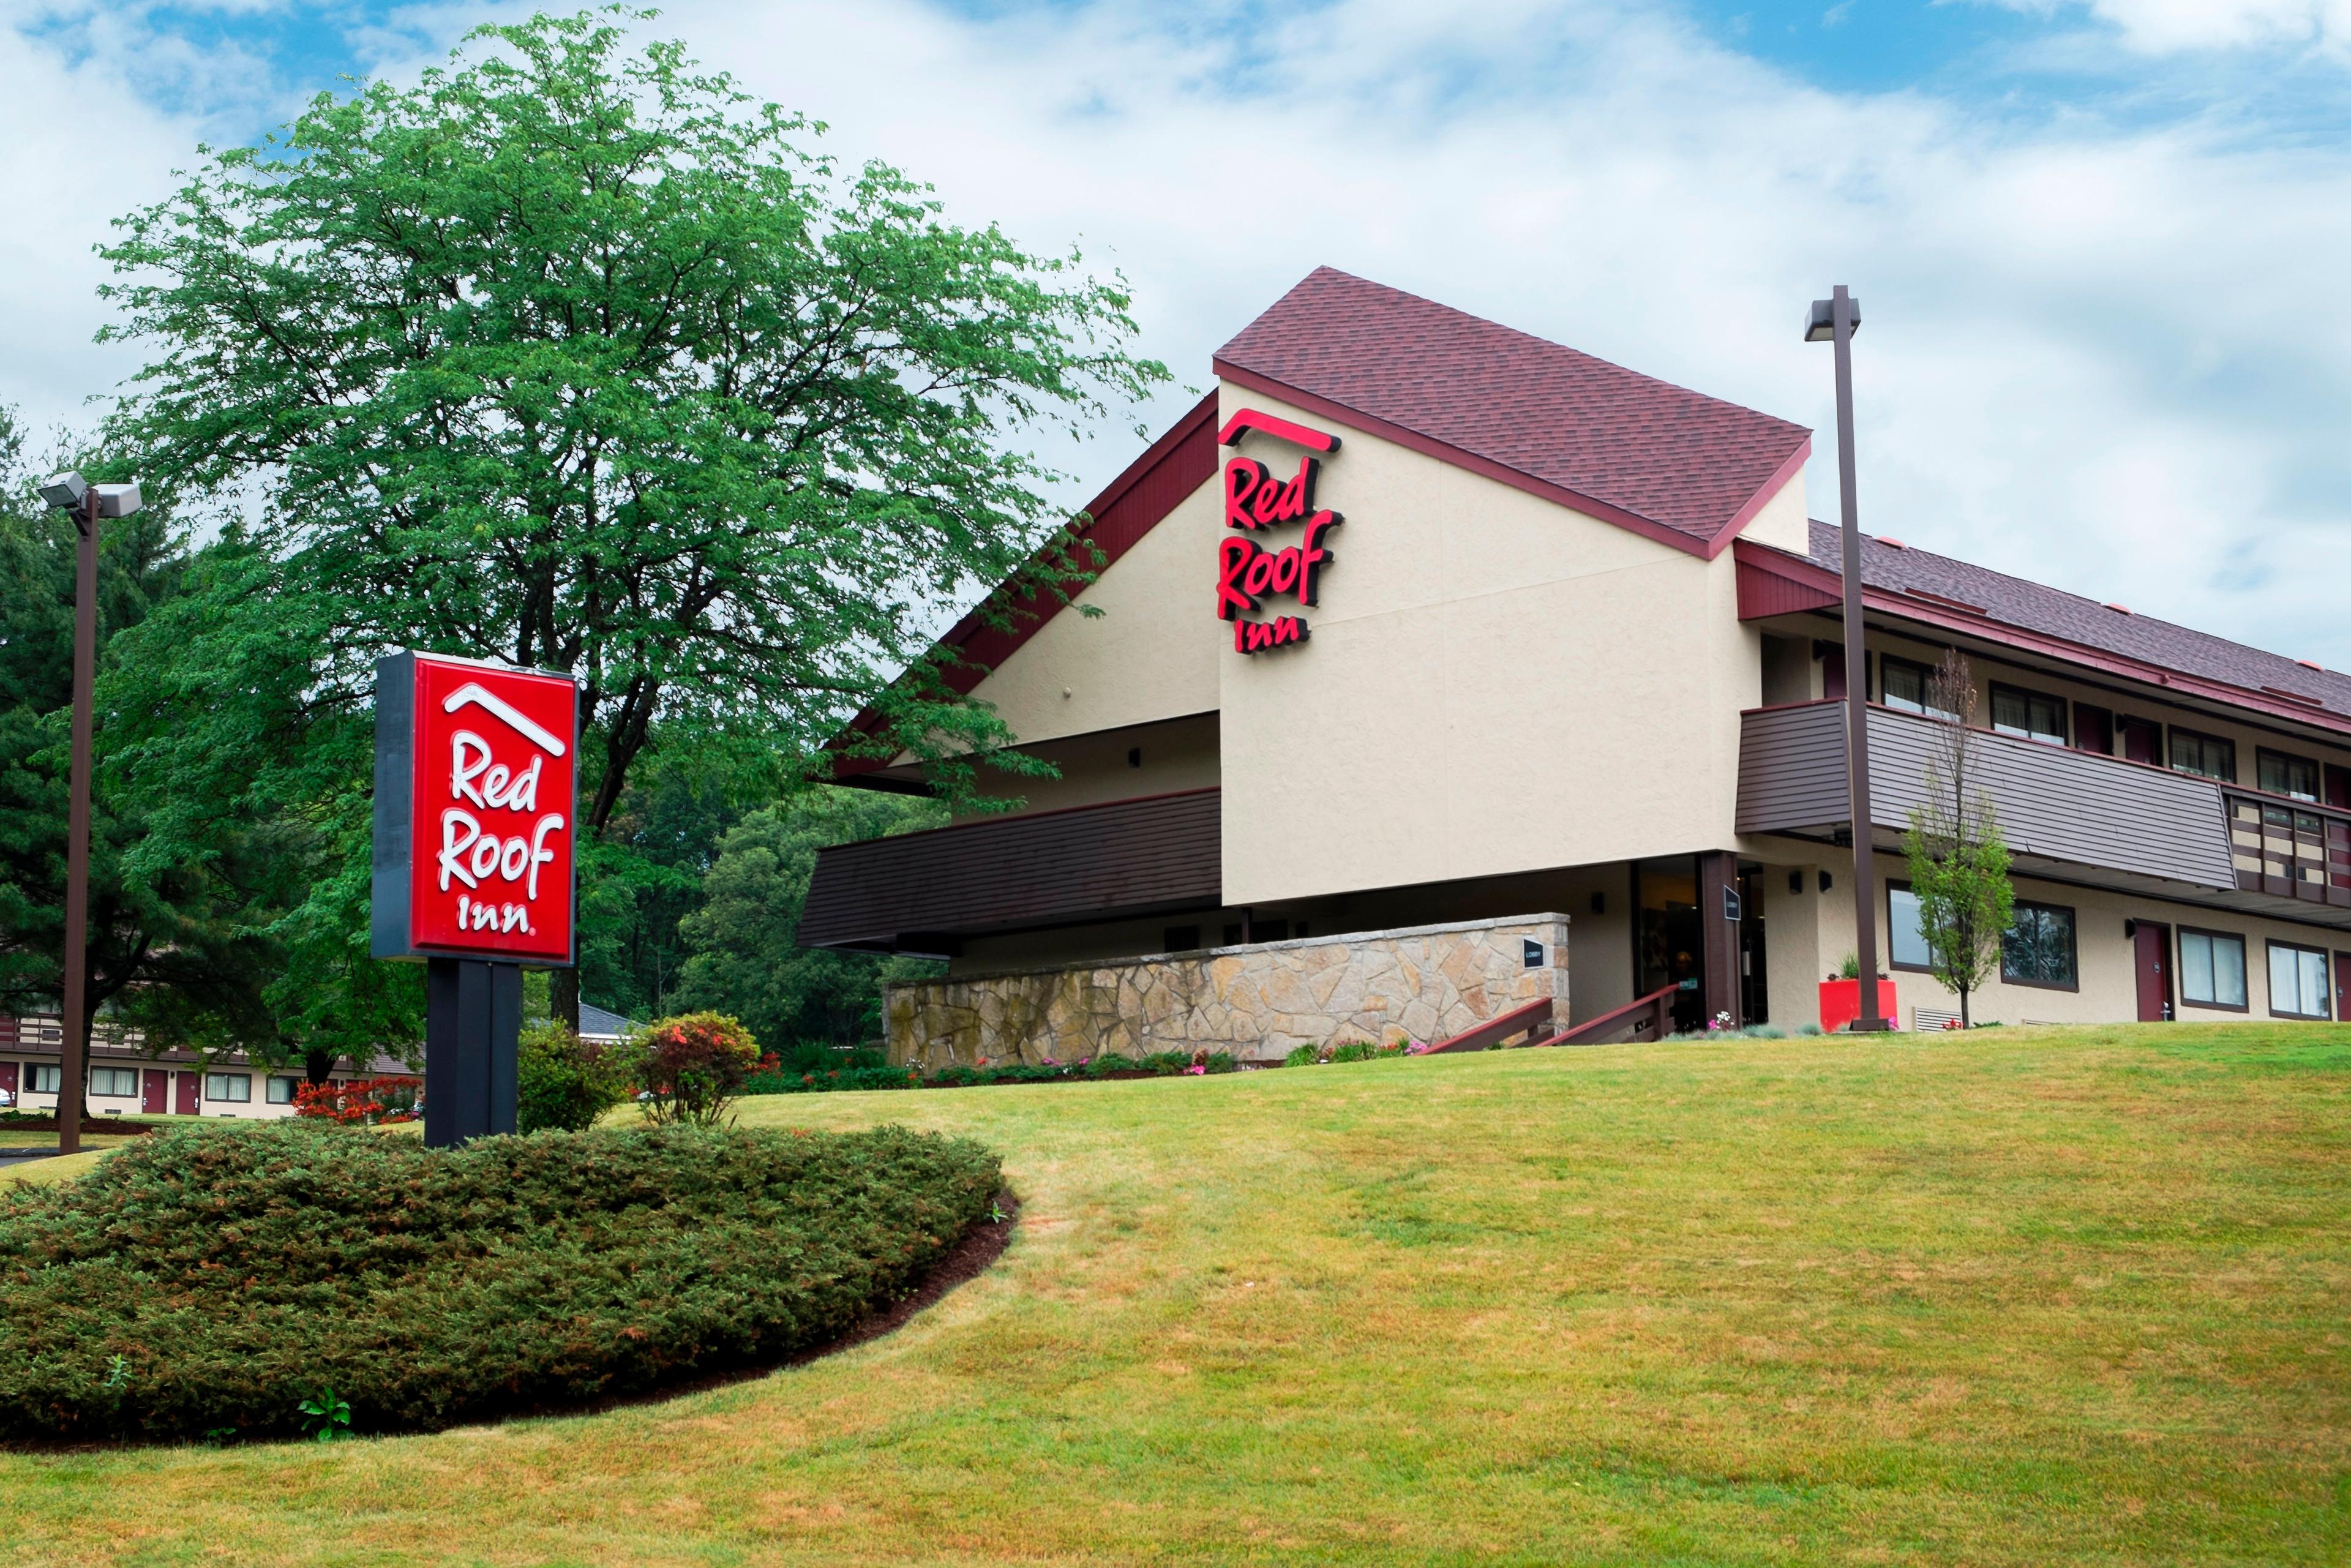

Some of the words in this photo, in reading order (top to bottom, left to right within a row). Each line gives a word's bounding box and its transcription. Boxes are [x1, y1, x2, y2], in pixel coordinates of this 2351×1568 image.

[1225, 456, 1311, 530] Red
[1217, 509, 1335, 620] Roof
[1234, 616, 1302, 653] Inn
[450, 729, 542, 811] Red
[438, 808, 564, 901] Roof
[458, 895, 529, 934] Inn
